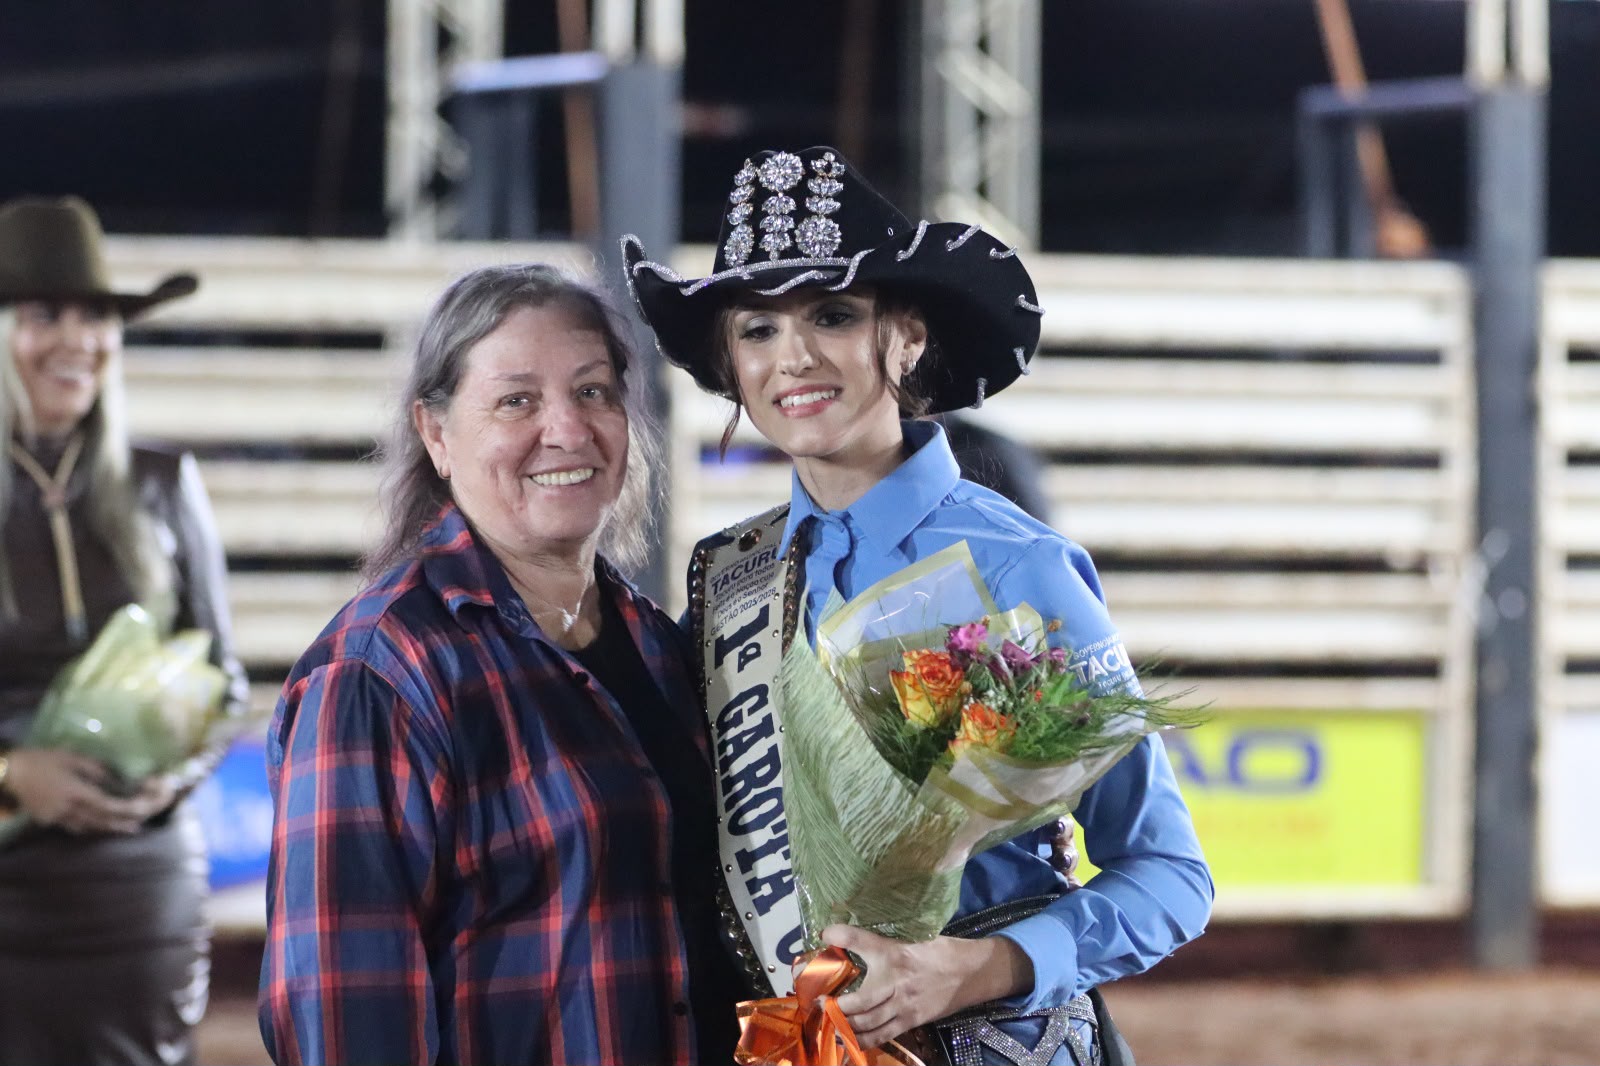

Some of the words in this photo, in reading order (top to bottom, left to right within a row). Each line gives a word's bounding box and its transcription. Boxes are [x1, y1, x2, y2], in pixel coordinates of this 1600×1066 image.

[736, 580, 759, 594] Nação
[737, 573, 754, 587] para
[755, 563, 775, 577] todos
[743, 582, 769, 599] Senhor
[711, 608, 739, 636] GESTÃO
[739, 587, 777, 614] 2025/2028
[716, 683, 794, 917] GAROTA
